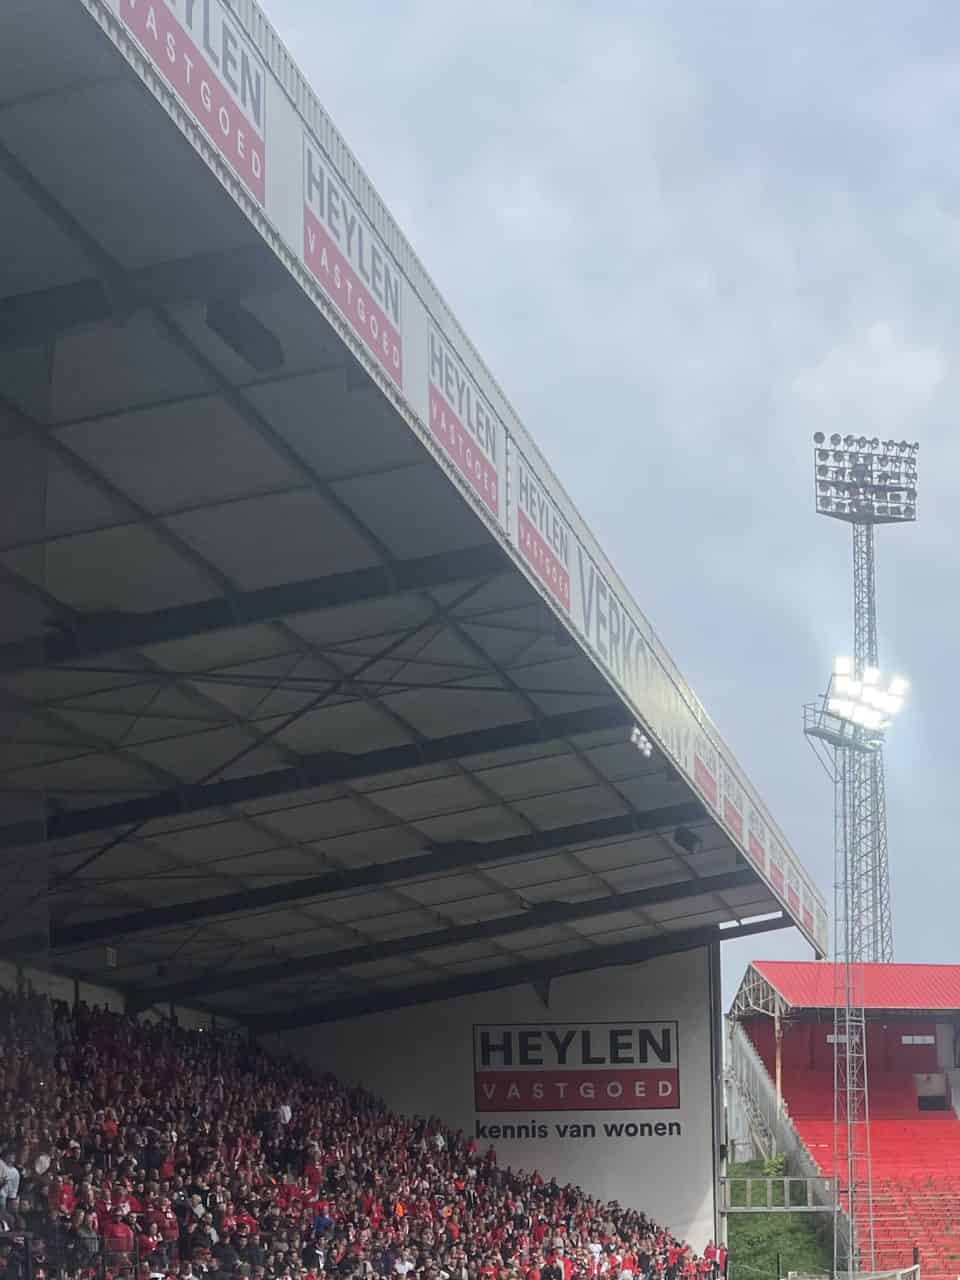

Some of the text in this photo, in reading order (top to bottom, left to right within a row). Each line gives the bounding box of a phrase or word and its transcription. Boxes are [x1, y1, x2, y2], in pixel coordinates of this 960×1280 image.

[129, 0, 261, 179] ASTGOED
[307, 149, 399, 325] HEYLEN
[309, 227, 400, 369] VASTGOED
[430, 334, 497, 463] HEYLEN
[519, 466, 569, 566] HEYLEN
[481, 1029, 672, 1065] HEYLEN
[483, 1081, 672, 1099] VASTGOED
[476, 1120, 681, 1138] kennis van wonen
